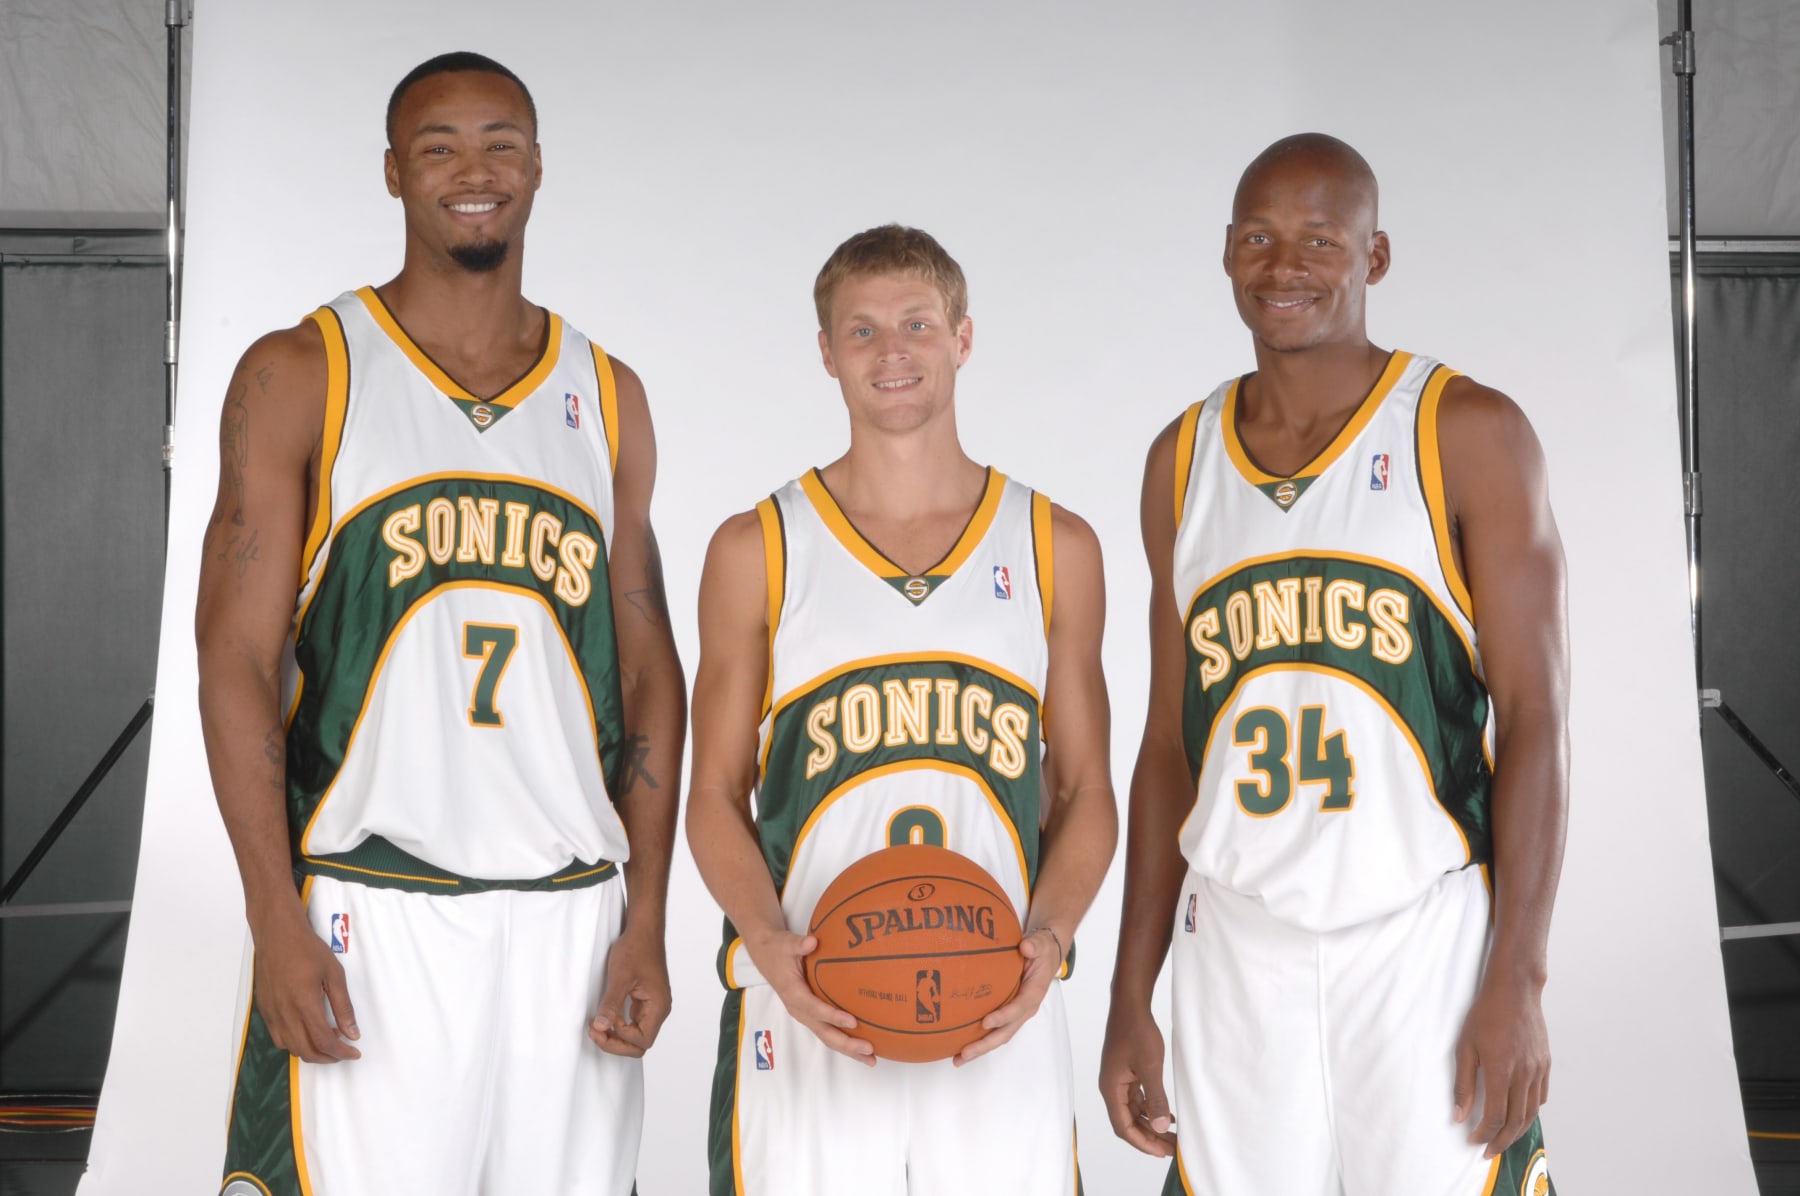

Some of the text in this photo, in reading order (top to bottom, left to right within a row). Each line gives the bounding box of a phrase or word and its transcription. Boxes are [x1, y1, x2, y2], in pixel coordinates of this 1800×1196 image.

[382, 496, 598, 607] SONICS
[462, 621, 519, 728] 7
[1190, 576, 1413, 692] SONICS
[805, 678, 1030, 780] SONICS
[1232, 704, 1355, 818] 34
[845, 904, 995, 949] SPALDING
